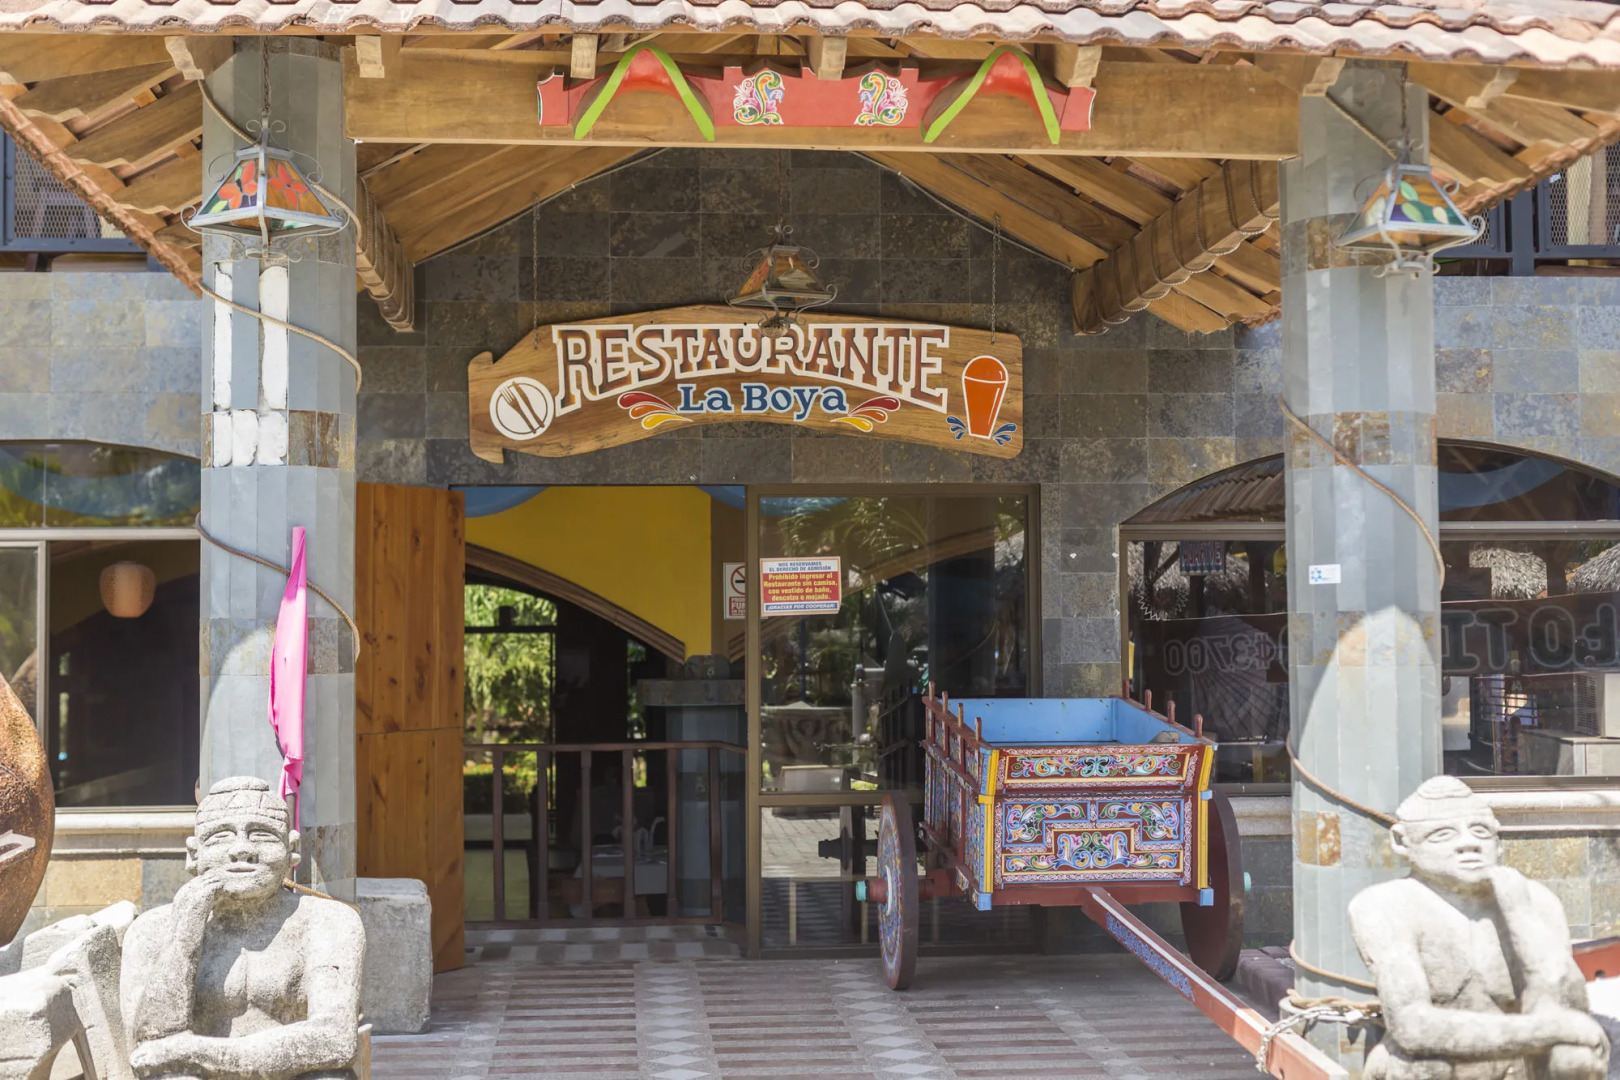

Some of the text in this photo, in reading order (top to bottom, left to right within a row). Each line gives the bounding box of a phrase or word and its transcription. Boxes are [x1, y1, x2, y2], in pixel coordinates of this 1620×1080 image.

[552, 323, 949, 414] RESTAURANTE
[677, 382, 849, 421] La Boya
